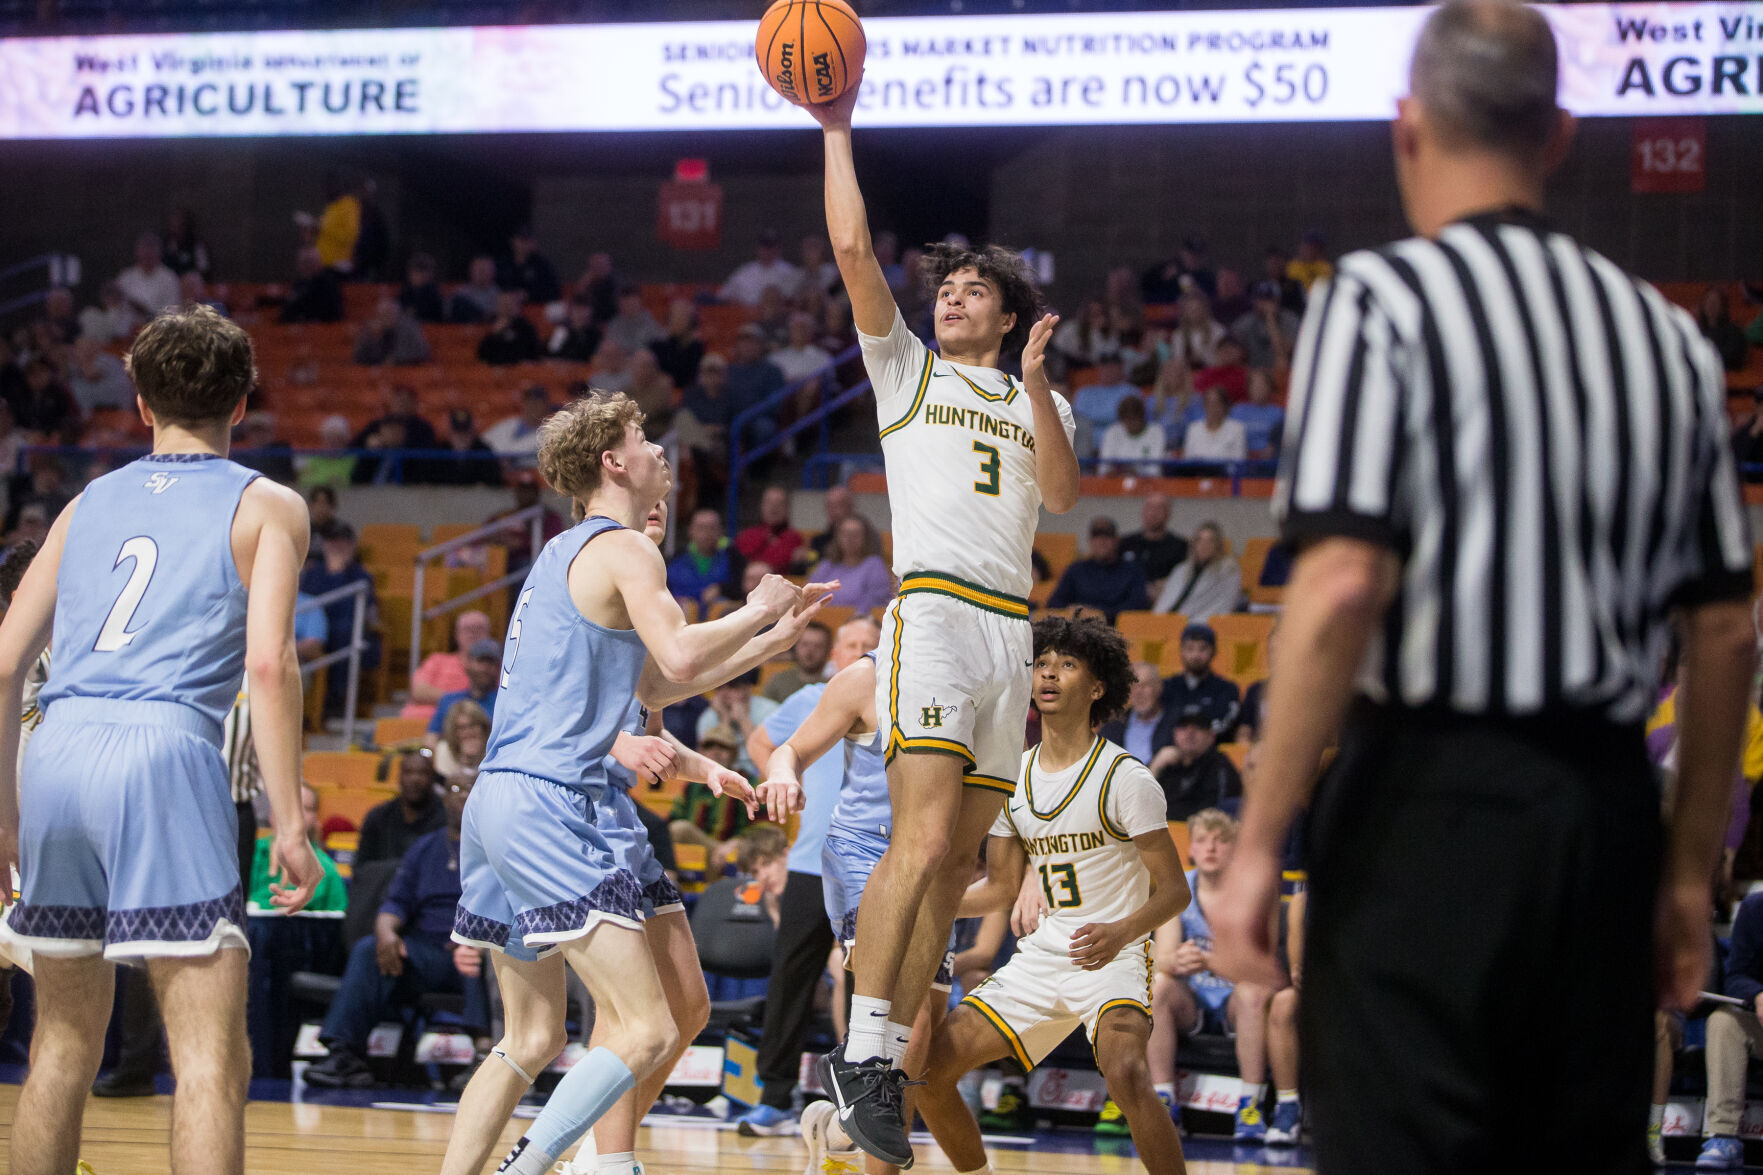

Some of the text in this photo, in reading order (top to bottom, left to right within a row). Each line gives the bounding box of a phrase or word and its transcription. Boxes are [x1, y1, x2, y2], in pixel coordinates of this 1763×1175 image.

[902, 38, 1011, 56] MARKET
[1022, 34, 1176, 54] NUTRITION
[1188, 30, 1329, 51] PROGRAM
[1616, 17, 1702, 41] West
[660, 61, 1329, 113] Senio enefits are now $50
[812, 52, 834, 96] NCAA
[73, 79, 420, 117] AGRICULTURE
[1639, 138, 1700, 173] 132
[143, 471, 180, 495] SV
[972, 439, 1002, 497] 3
[91, 534, 160, 652] 2
[921, 706, 943, 727] H
[1038, 862, 1083, 909] 13
